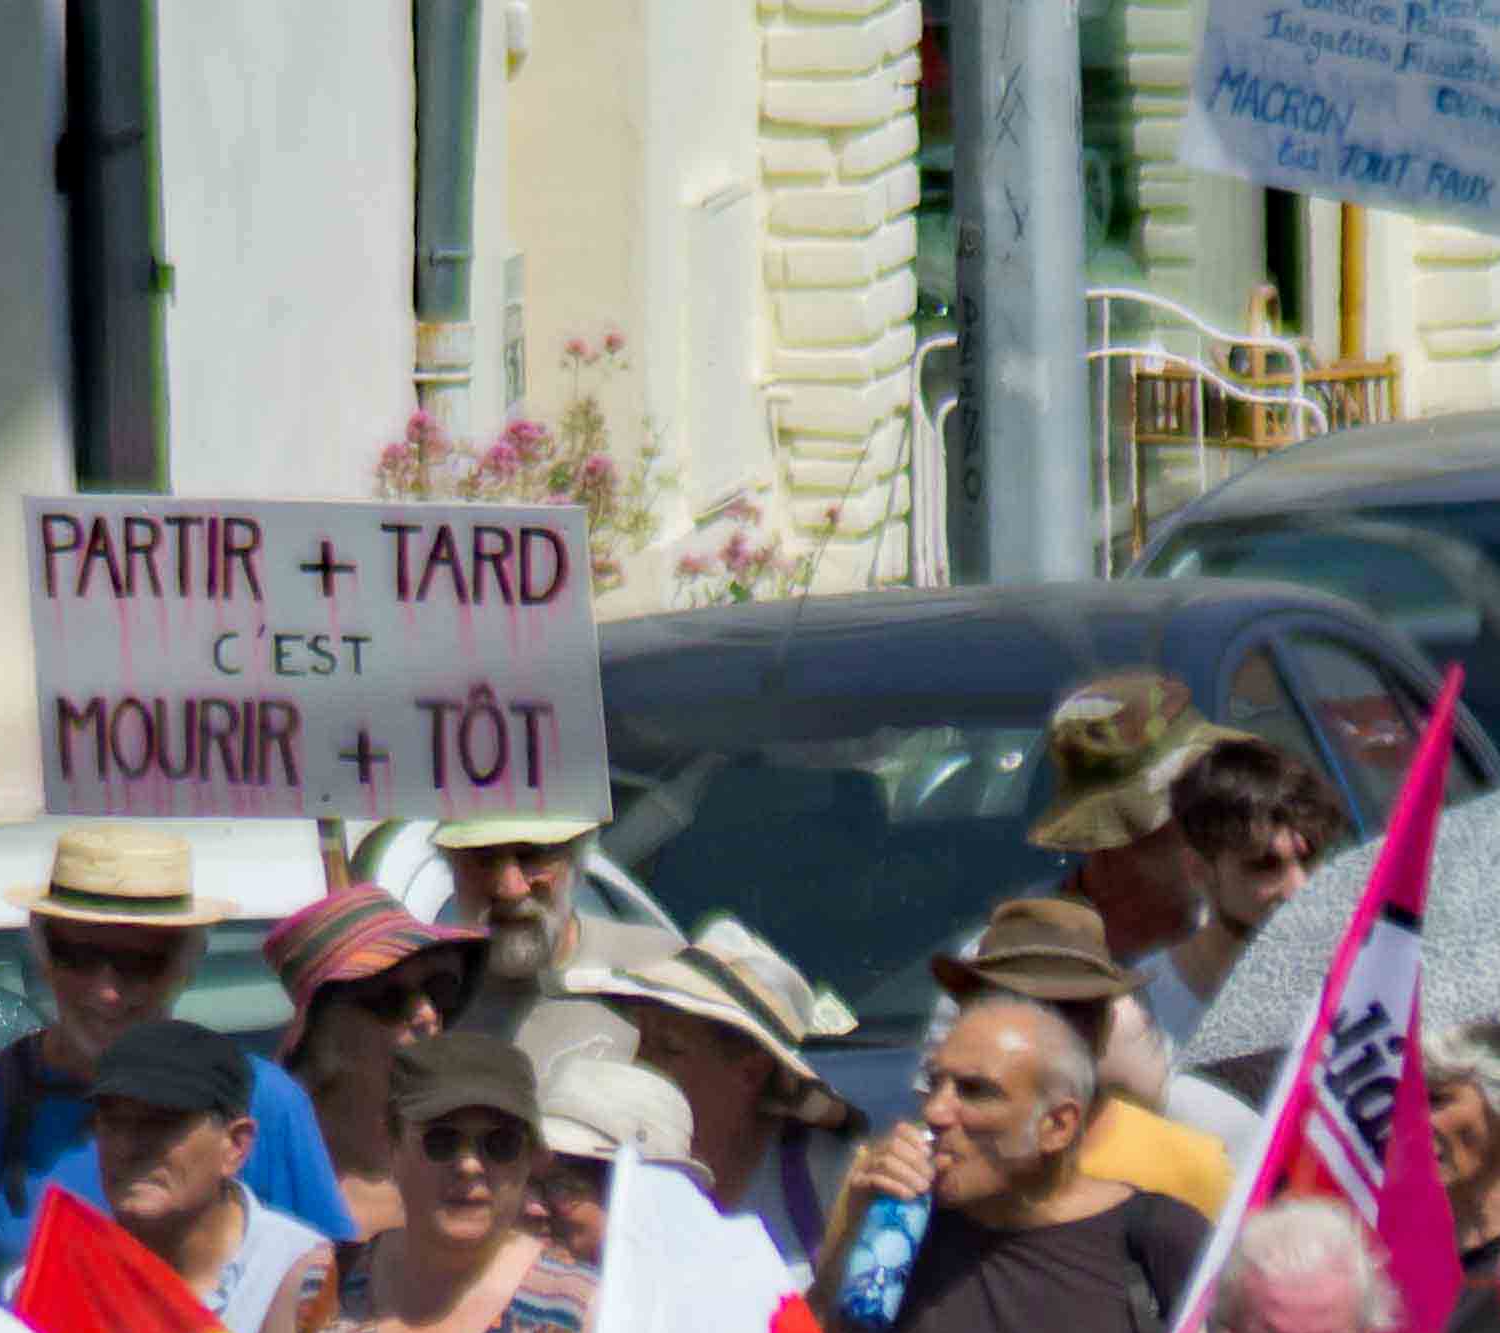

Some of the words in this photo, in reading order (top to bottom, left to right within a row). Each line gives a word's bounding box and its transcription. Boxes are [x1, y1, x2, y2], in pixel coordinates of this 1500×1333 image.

[1206, 64, 1356, 140] MACRON
[41, 512, 263, 602] PARTIR
[300, 540, 357, 598] +
[381, 522, 570, 606] TARD
[212, 624, 373, 677] C'EST
[56, 696, 300, 787] MOURIR
[338, 730, 390, 785] +
[414, 682, 555, 791] TÔT
